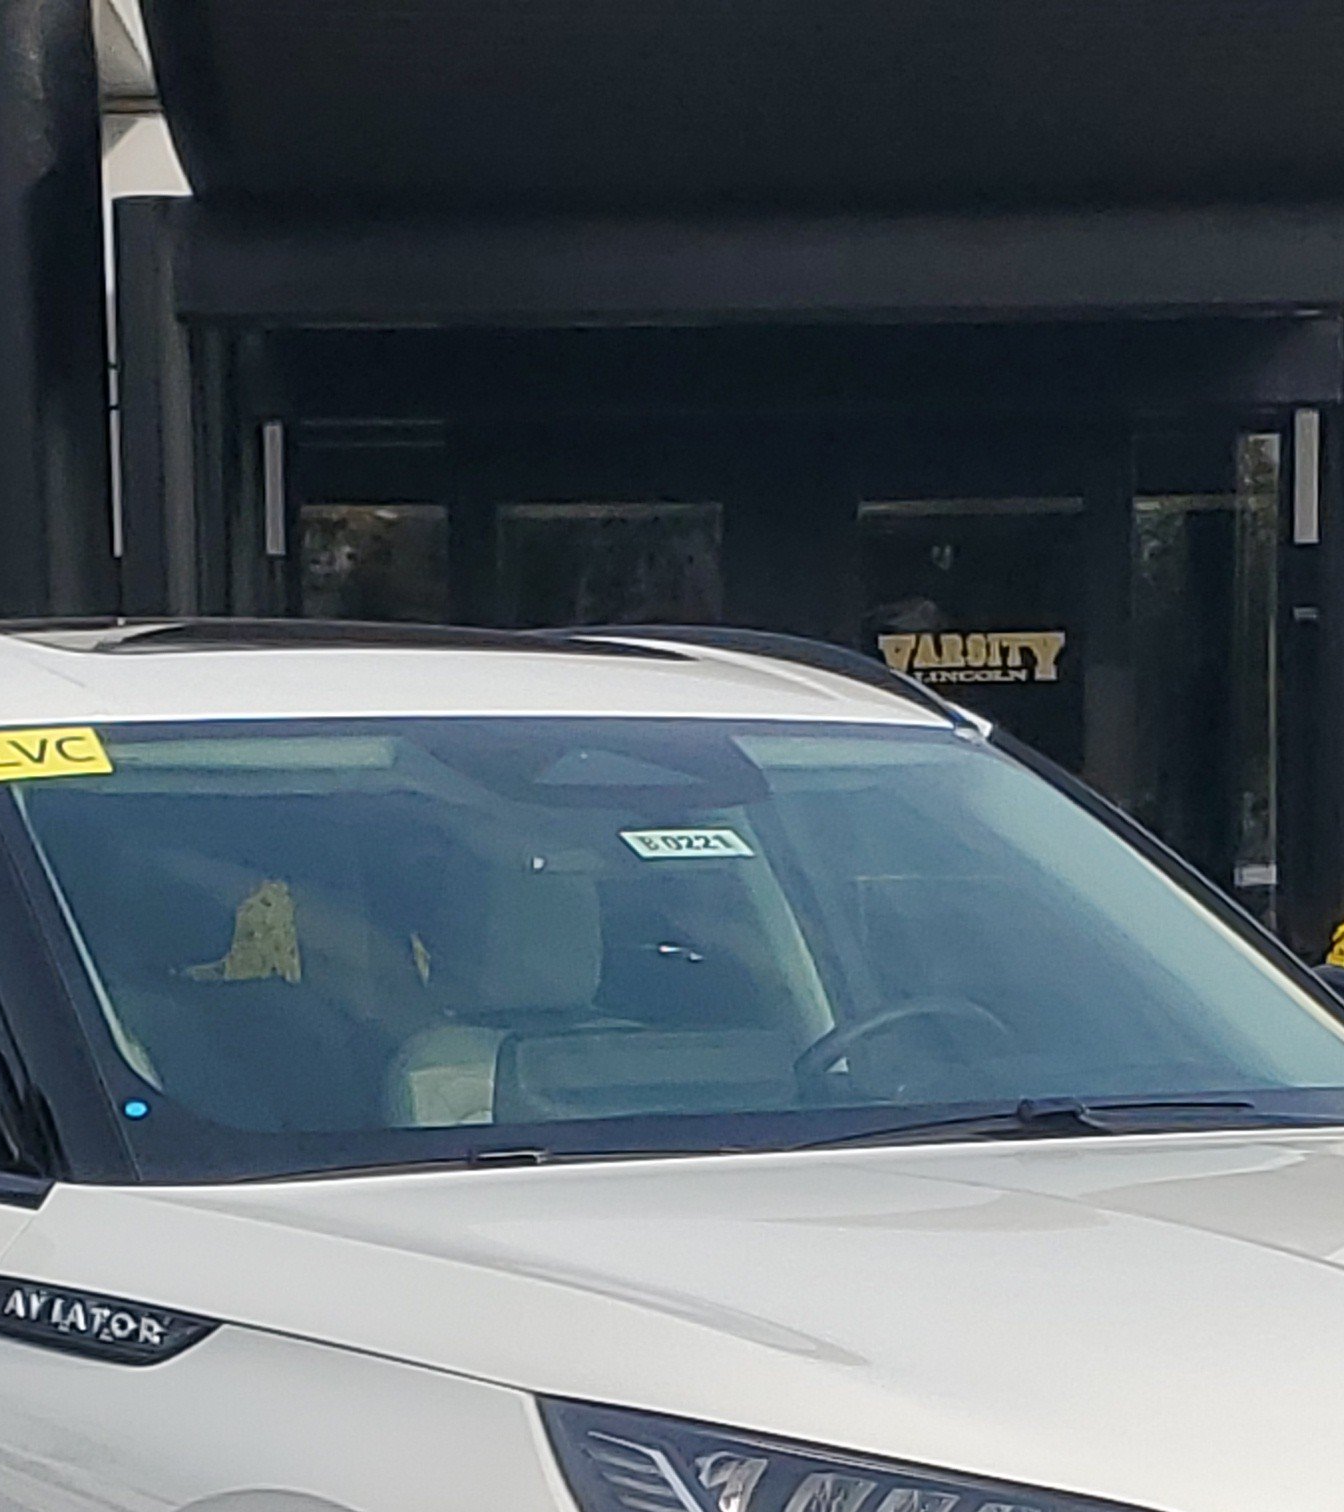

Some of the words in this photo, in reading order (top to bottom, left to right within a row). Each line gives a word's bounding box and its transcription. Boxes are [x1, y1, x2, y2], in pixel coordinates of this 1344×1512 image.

[877, 632, 1065, 681] VARSITY
[661, 834, 732, 850] 0221
[3, 1288, 168, 1346] AVIATOR
